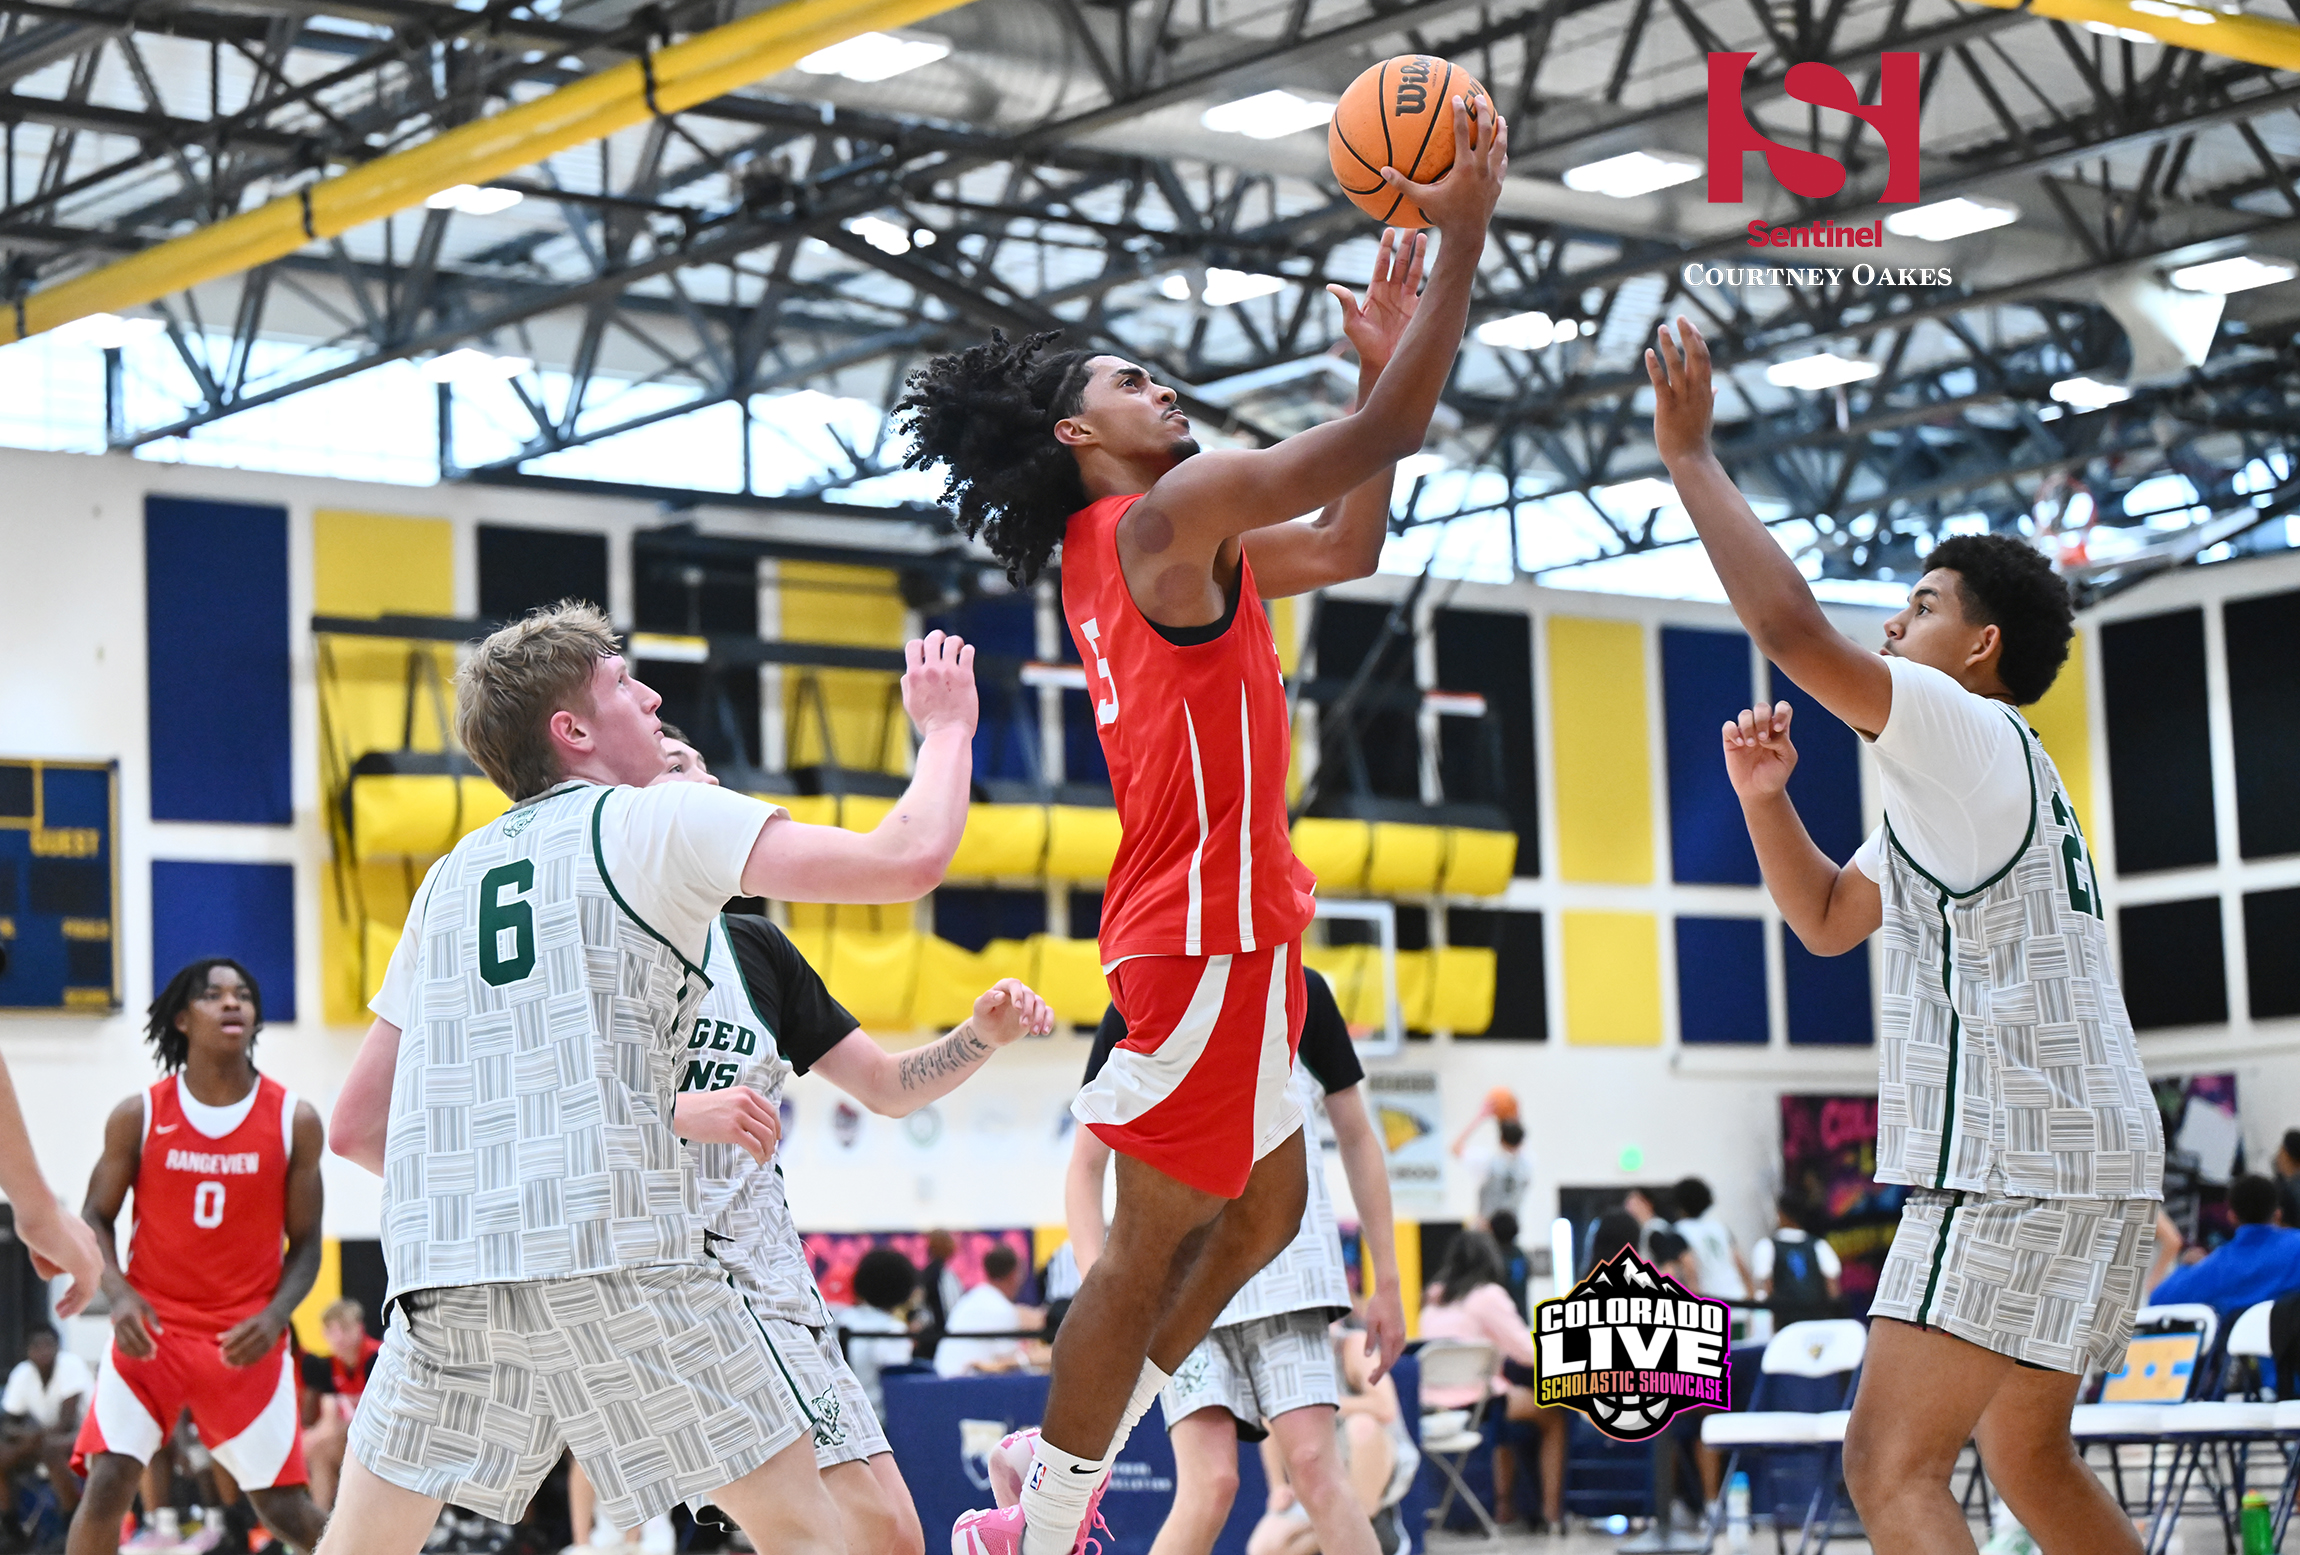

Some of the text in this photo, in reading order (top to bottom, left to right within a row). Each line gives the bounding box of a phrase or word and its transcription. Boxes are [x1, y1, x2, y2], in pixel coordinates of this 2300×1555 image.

[1395, 54, 1434, 117] Wilso
[1080, 617, 1119, 725] 5
[479, 857, 536, 987] 6
[164, 1148, 260, 1175] RANGEVIEW
[193, 1180, 226, 1229] 0
